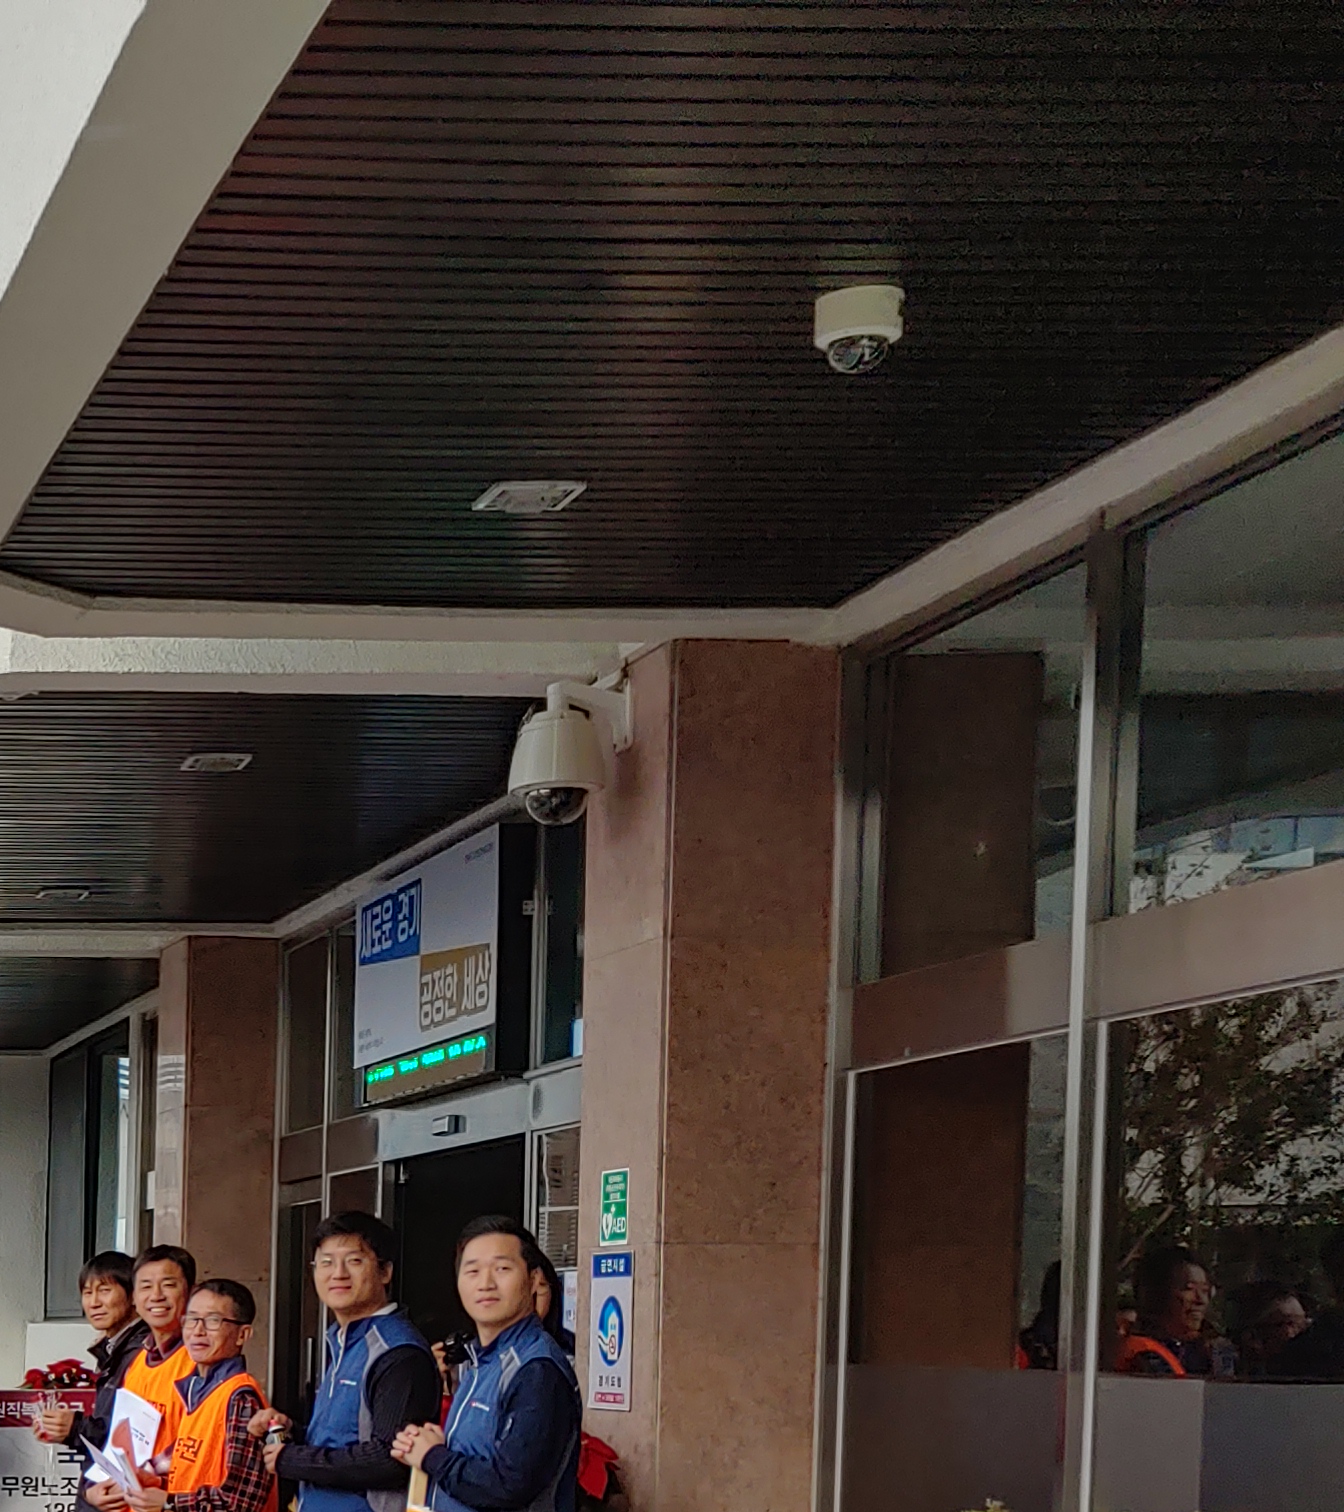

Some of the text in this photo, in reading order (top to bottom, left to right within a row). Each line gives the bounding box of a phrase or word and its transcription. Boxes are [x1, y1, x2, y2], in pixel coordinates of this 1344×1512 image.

[362, 887, 421, 959] 새로운 경기
[420, 949, 491, 1025] 공정한 세상
[612, 1216, 626, 1233] AED
